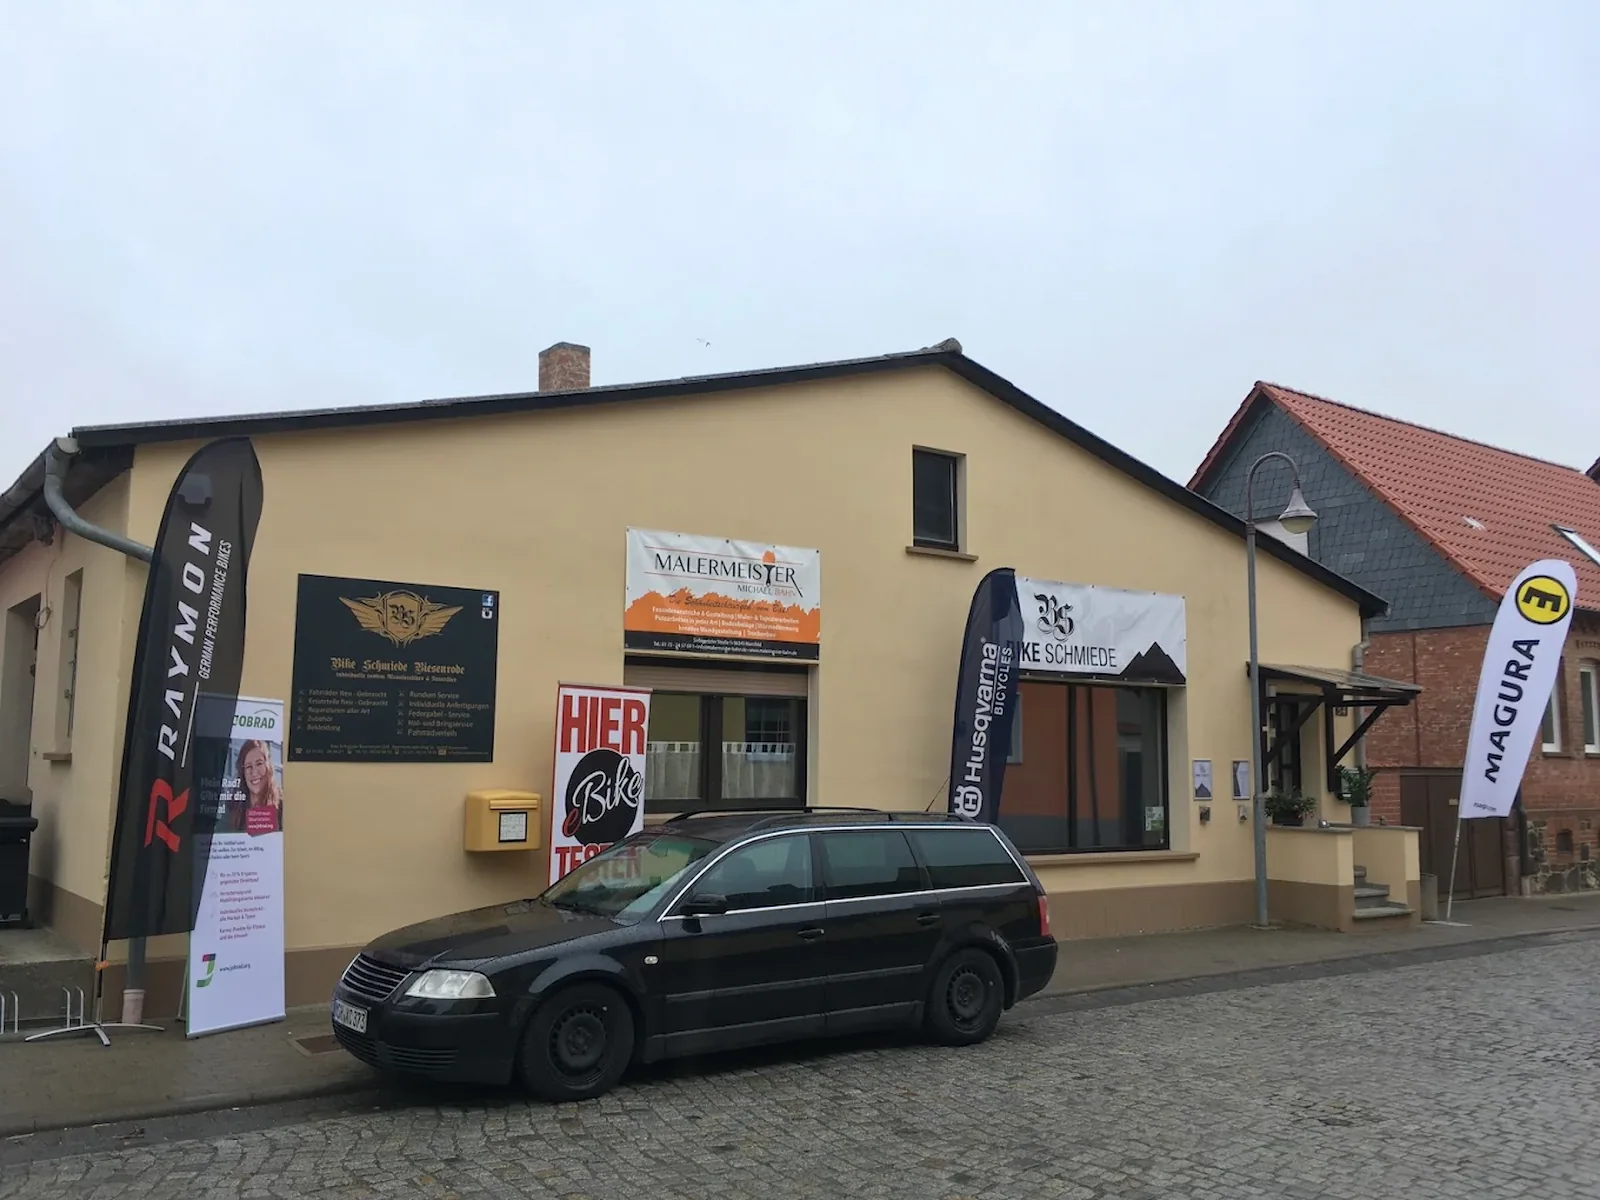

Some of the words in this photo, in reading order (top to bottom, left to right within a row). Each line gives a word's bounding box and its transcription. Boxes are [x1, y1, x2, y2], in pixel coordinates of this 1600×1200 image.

[215, 539, 232, 569] BIKES
[655, 553, 801, 589] MALERMEISTER
[205, 567, 228, 639] PERFORMANCE
[737, 584, 773, 595] MICHAEL
[156, 522, 213, 760] RAYMON
[198, 637, 215, 680] GERMAN
[1045, 643, 1117, 668] SCHMIEDE
[994, 647, 1012, 716] BICYCLES
[560, 695, 646, 755] HIER
[964, 642, 1000, 782] Husqvarna
[1484, 639, 1540, 784] MAGURA
[220, 791, 233, 800] mir
[234, 790, 246, 801] die
[222, 778, 241, 788] Rad?
